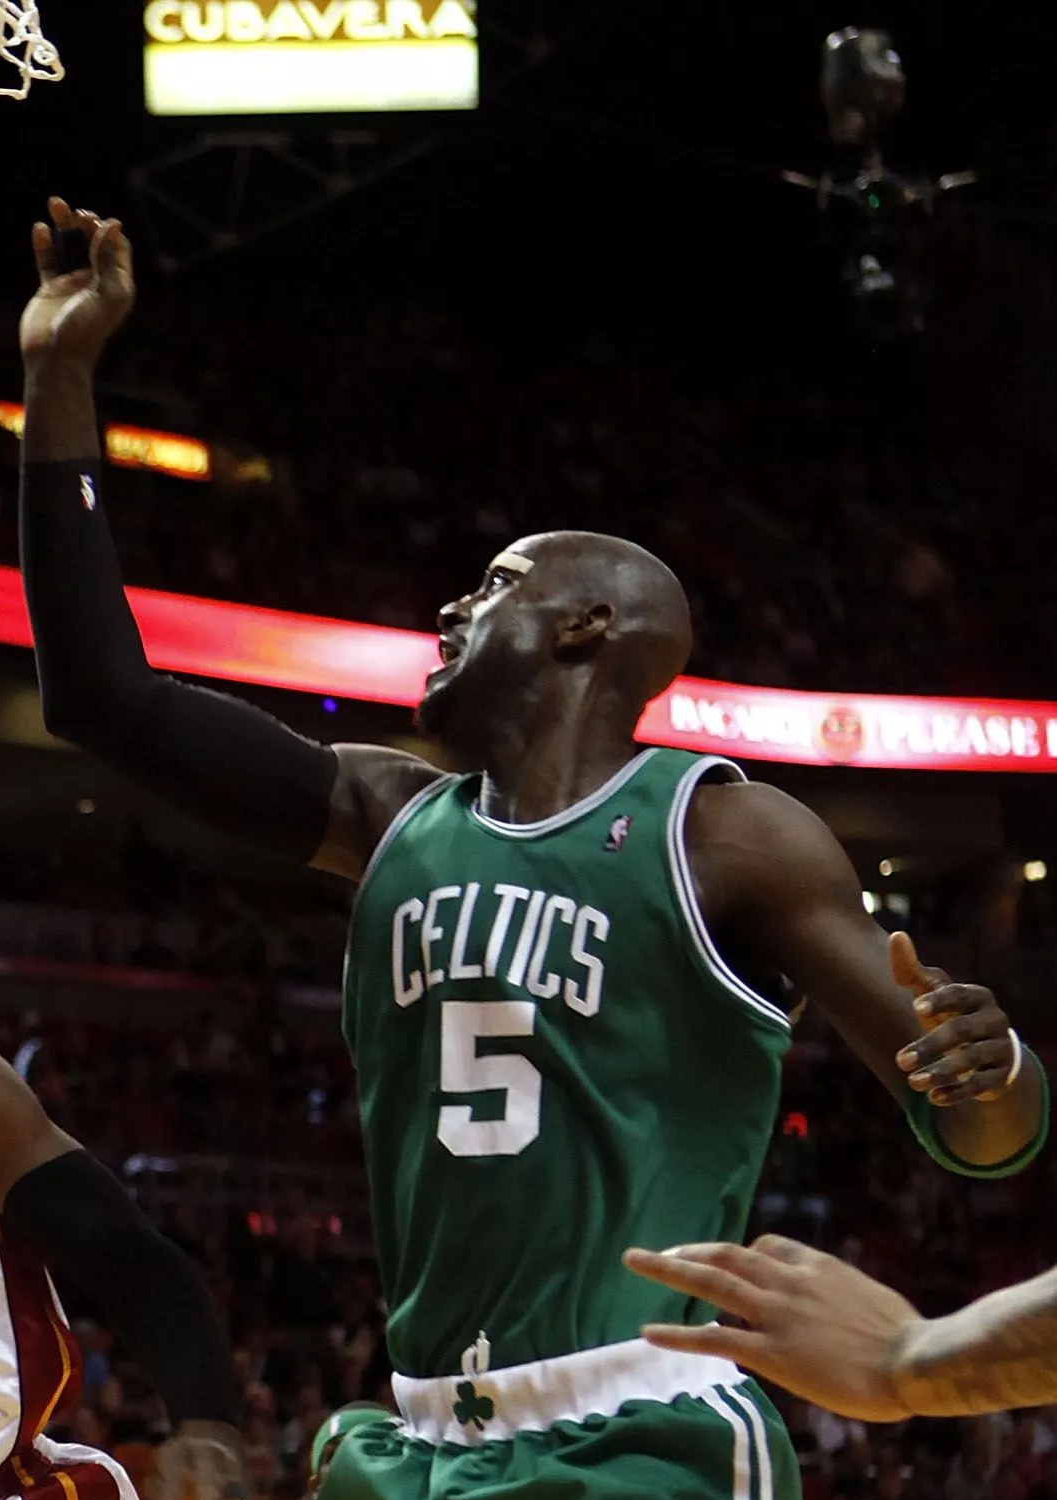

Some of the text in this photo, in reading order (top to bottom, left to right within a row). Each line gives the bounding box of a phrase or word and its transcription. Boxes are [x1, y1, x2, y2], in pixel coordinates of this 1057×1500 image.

[143, 0, 478, 42] CUBAVERA
[392, 882, 611, 1018] CELTICS
[437, 1000, 542, 1157] 5
